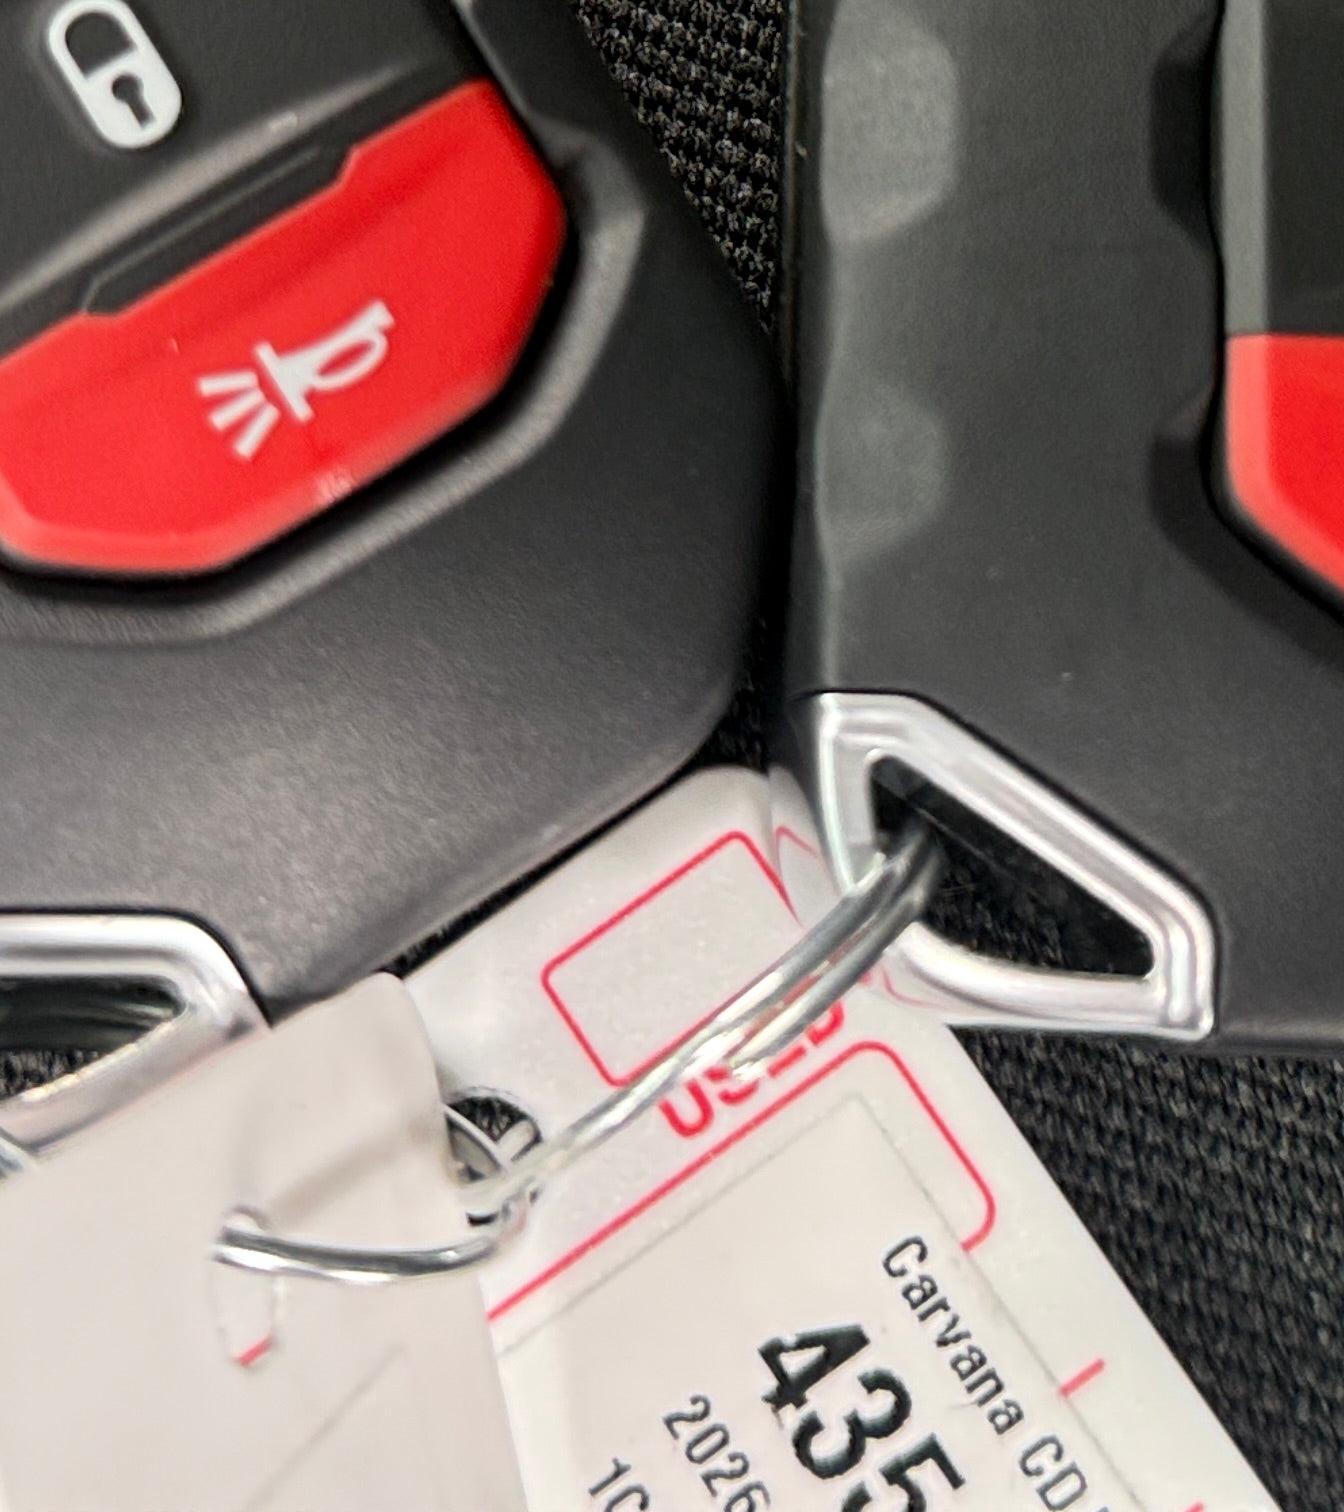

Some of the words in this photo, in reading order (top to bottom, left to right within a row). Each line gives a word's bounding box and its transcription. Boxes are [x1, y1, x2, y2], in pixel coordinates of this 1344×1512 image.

[663, 1394, 771, 1512] 2026
[757, 1322, 966, 1512] 435
[882, 1235, 1025, 1435] Carvana
[1020, 1435, 1088, 1512] CD
